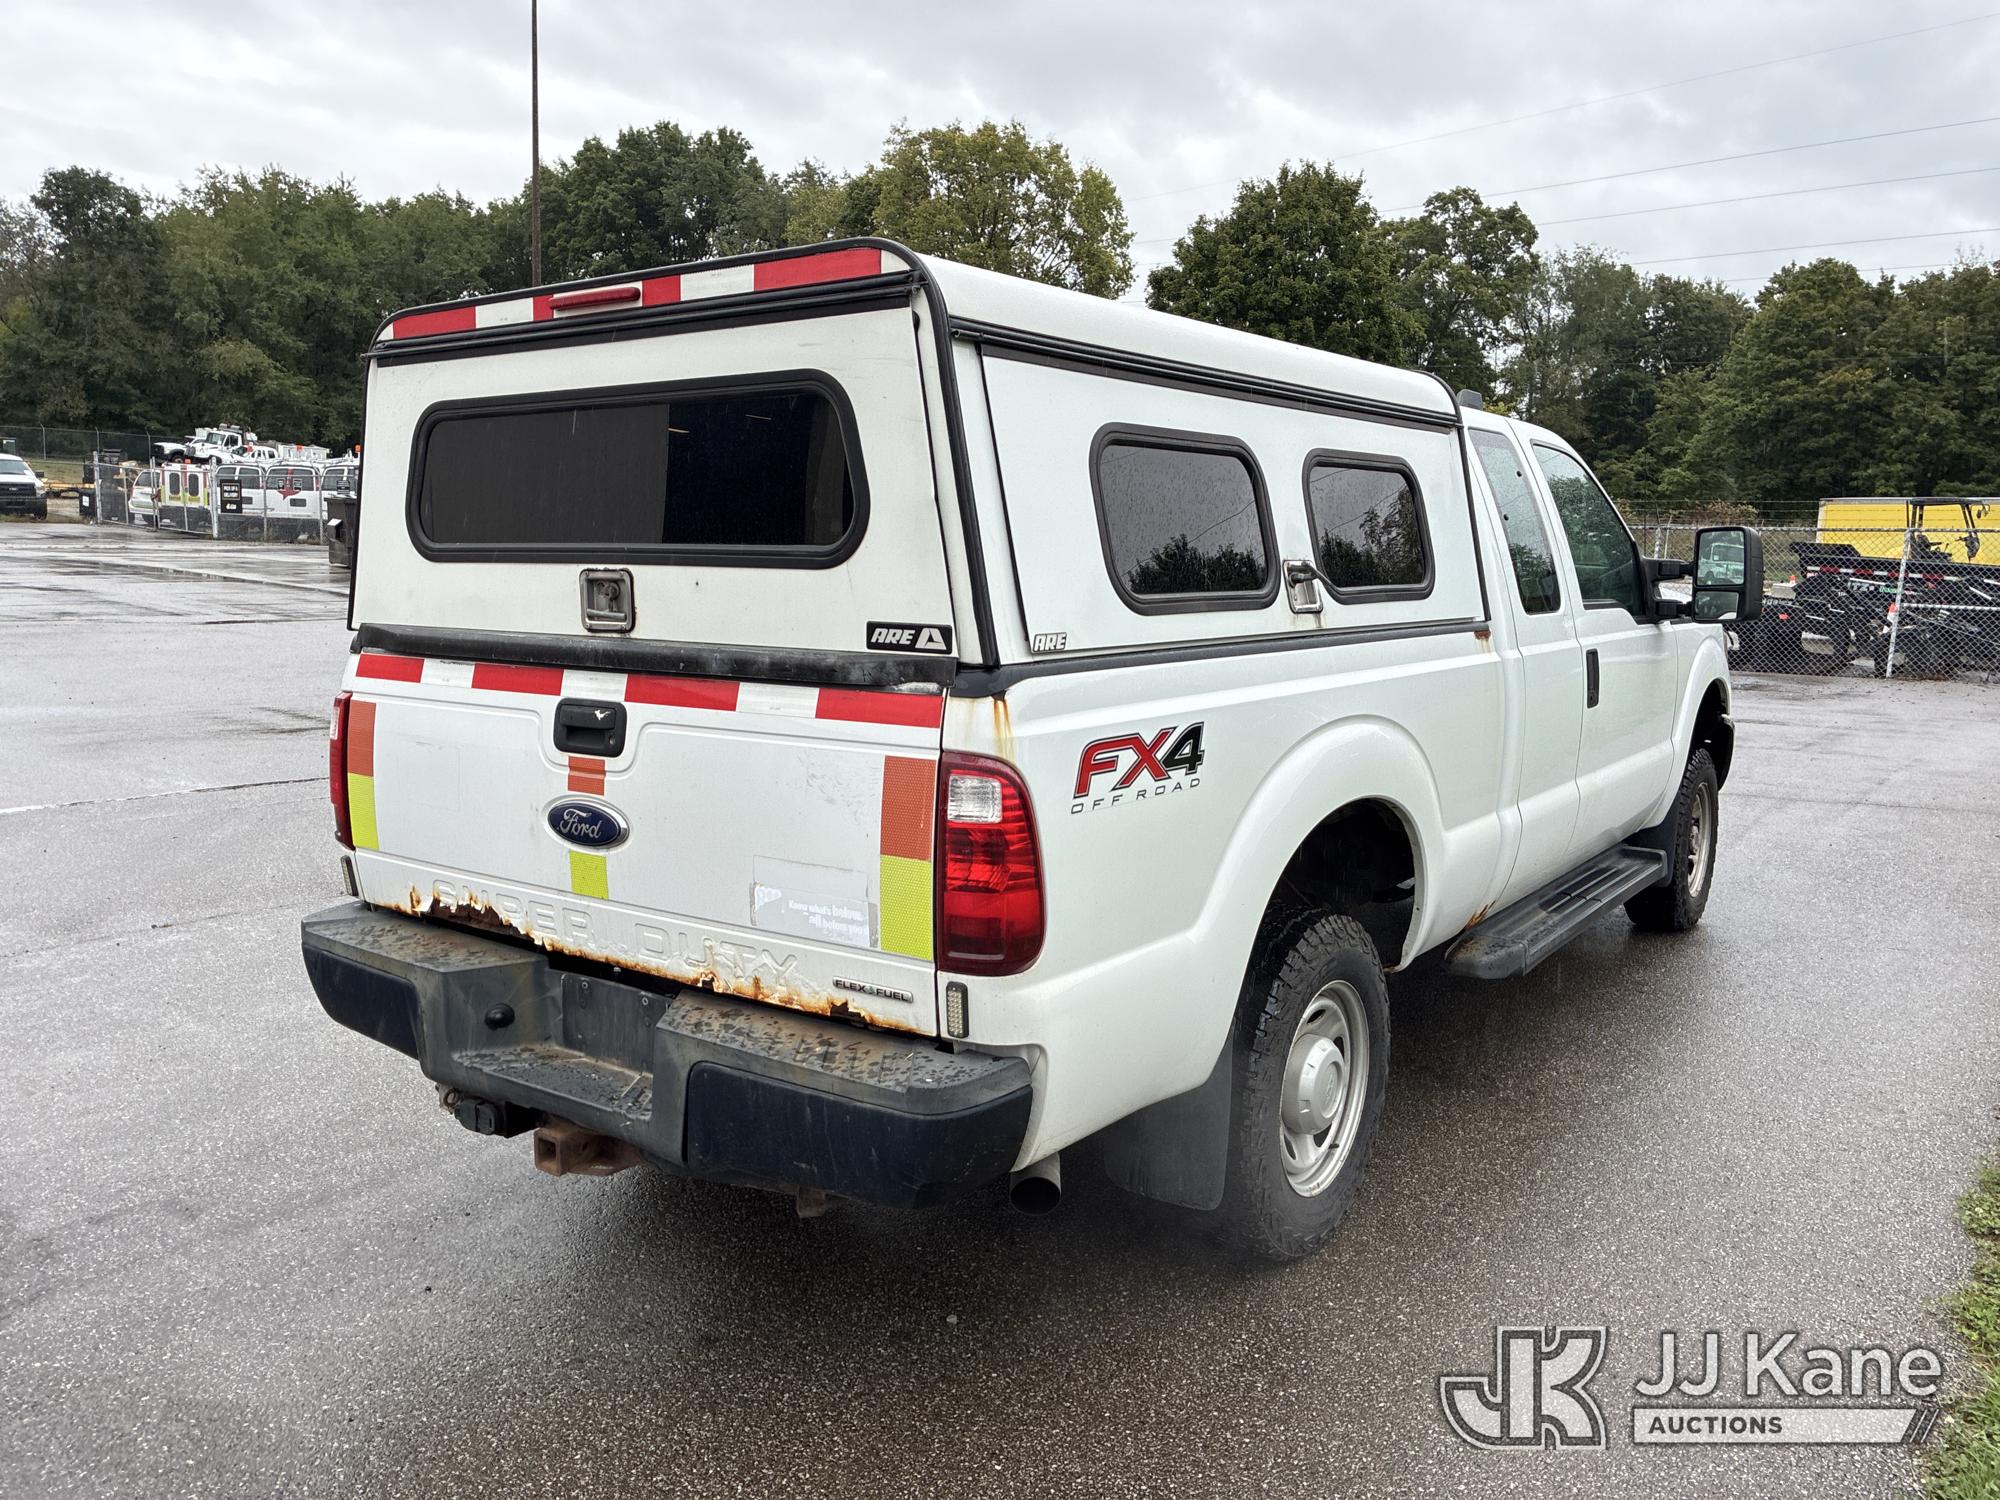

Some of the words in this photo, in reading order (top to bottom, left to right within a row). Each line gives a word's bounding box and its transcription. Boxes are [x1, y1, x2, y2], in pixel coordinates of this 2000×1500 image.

[870, 627, 916, 645] ARE
[1032, 632, 1068, 653] ARE
[1073, 721, 1205, 799] FX4
[1071, 794, 1123, 815] OFF
[1136, 778, 1201, 801] ROAD
[559, 809, 602, 837] Ford
[635, 922, 800, 984] DUTY
[835, 979, 867, 993] FLEX
[876, 988, 910, 1002] FUEL
